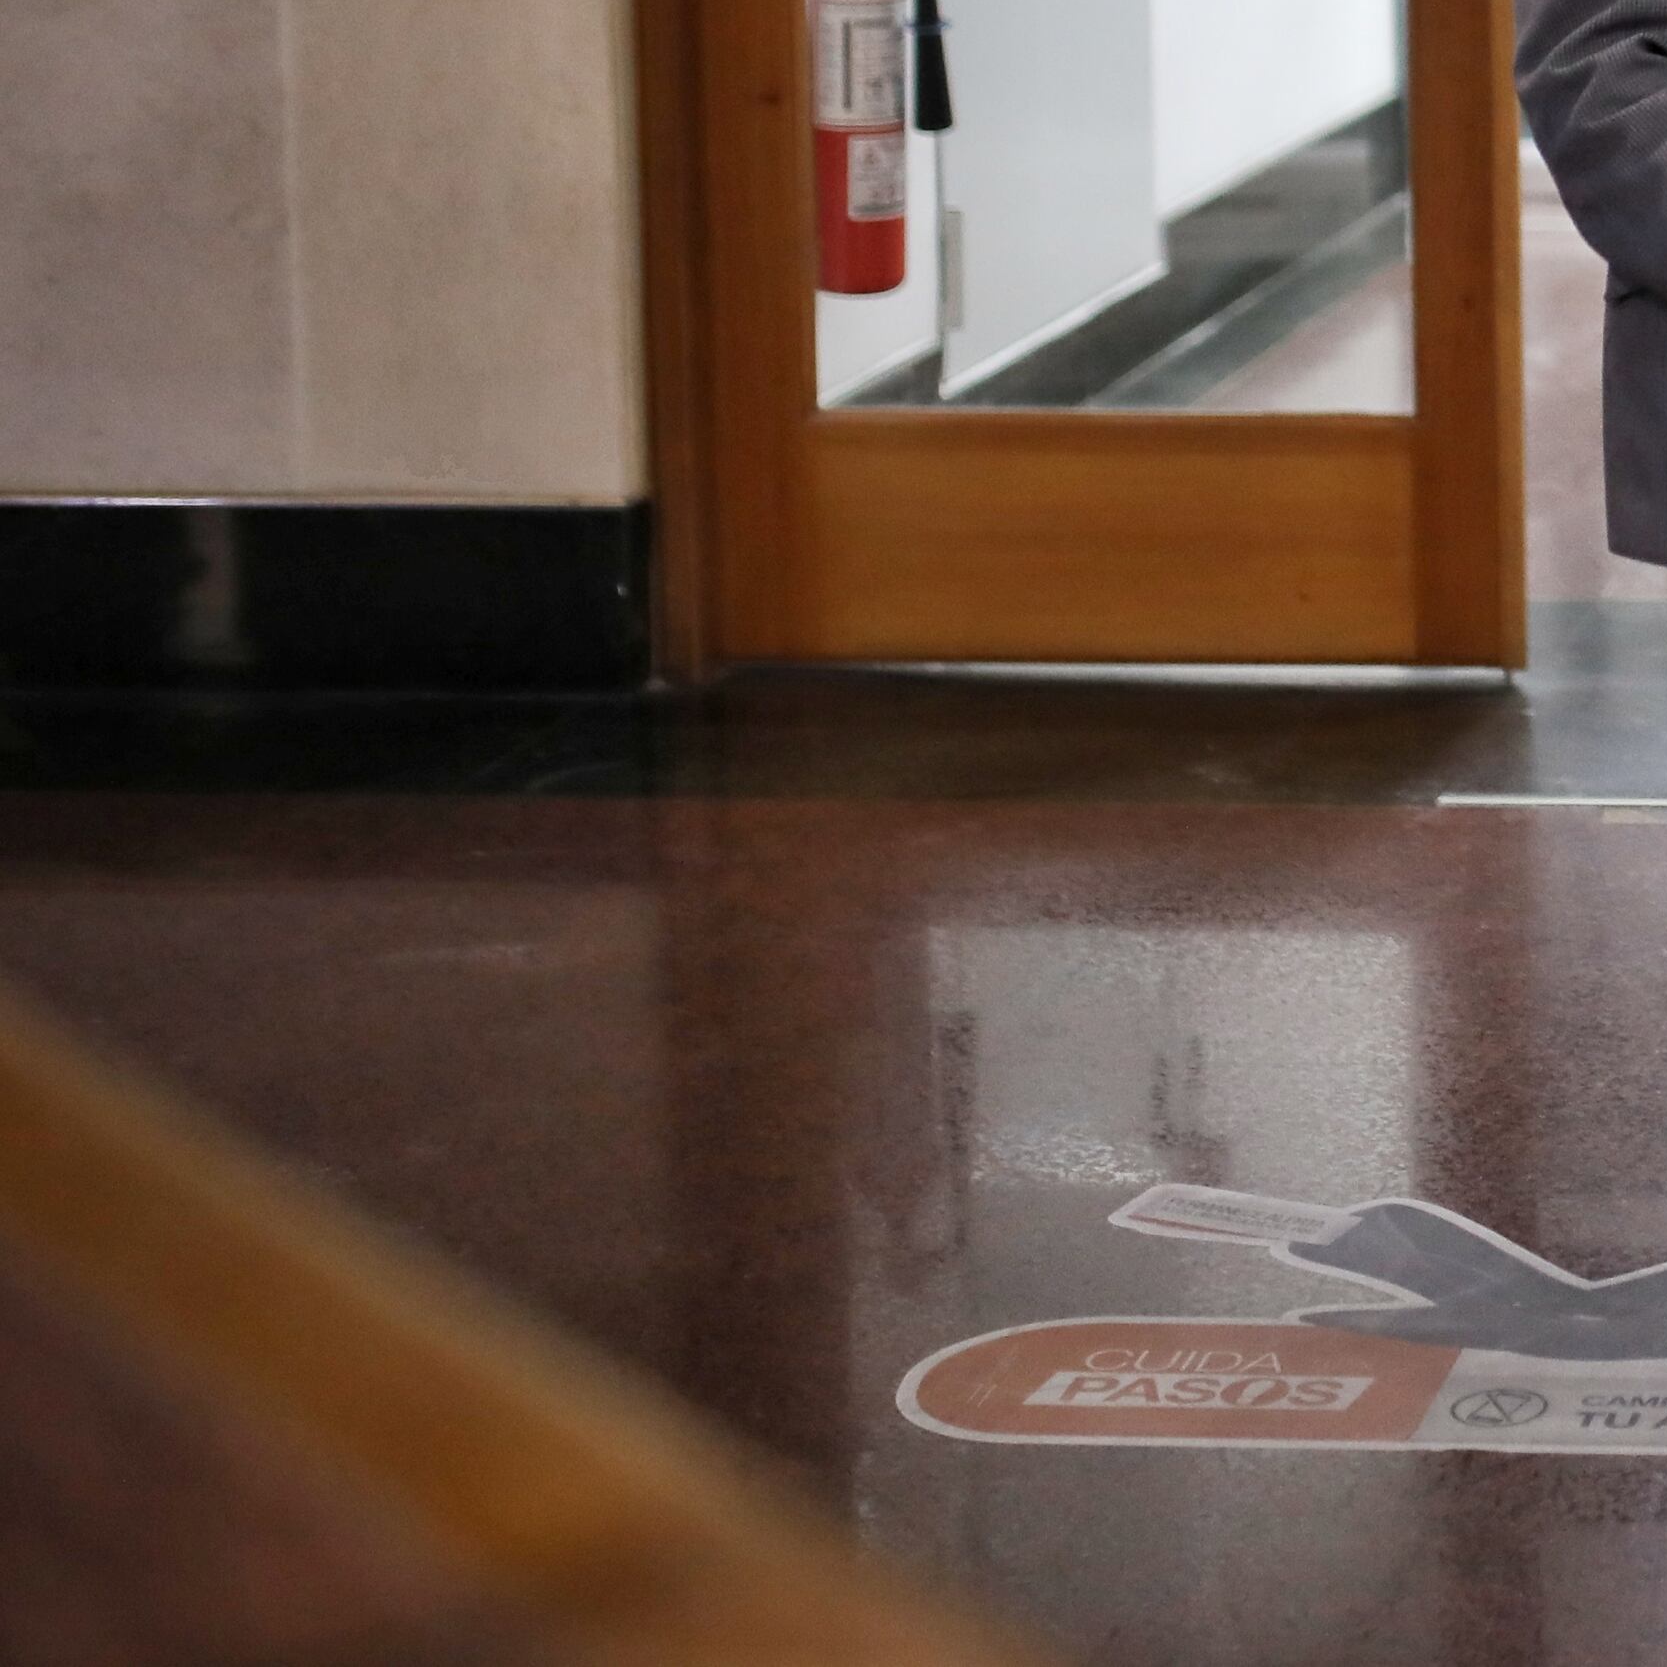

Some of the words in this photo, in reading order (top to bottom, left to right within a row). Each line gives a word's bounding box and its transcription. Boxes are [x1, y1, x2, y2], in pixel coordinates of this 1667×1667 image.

[1085, 1348, 1282, 1374] CUIDA
[1059, 1376, 1343, 1407] PASOS
[1578, 1411, 1642, 1430] TU
